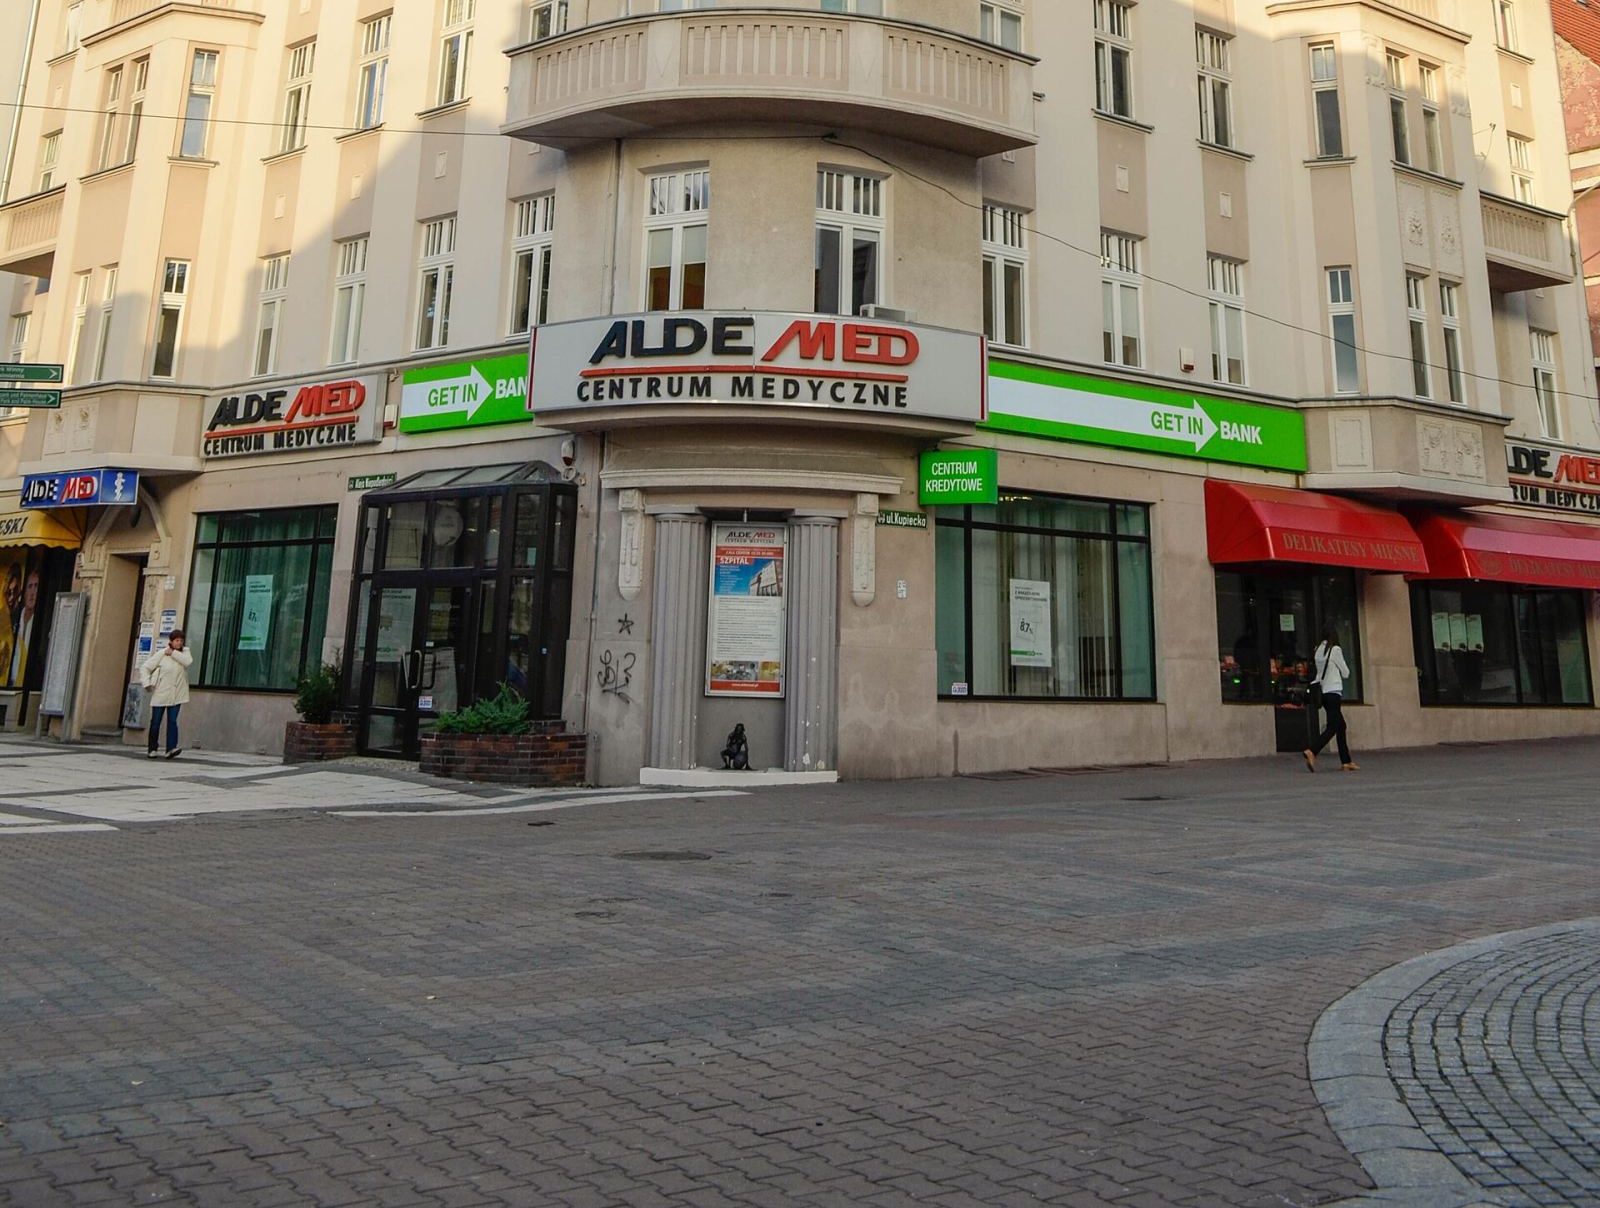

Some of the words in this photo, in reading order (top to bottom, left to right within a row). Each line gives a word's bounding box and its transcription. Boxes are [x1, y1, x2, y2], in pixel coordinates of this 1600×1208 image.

[588, 317, 754, 364] ALDE
[761, 320, 920, 366] MED
[207, 390, 287, 432] ALDE
[284, 379, 366, 424] MED
[428, 386, 459, 407] GET
[462, 383, 478, 404] IN
[495, 375, 528, 400] BAN
[577, 376, 712, 401] CENTRUM
[731, 376, 907, 408] MEDYCZNE
[204, 433, 265, 456] CENTRUM
[273, 423, 356, 449] MEDYCZNE
[1151, 411, 1183, 432] GET
[1188, 416, 1204, 435] IN
[1220, 420, 1263, 445] BANK
[931, 461, 978, 476] CENTRUM
[61, 475, 98, 504] MED
[925, 478, 983, 492] KREDYTOWE
[719, 556, 750, 565] SZPITAL
[1282, 533, 1367, 558] DELIKATESY
